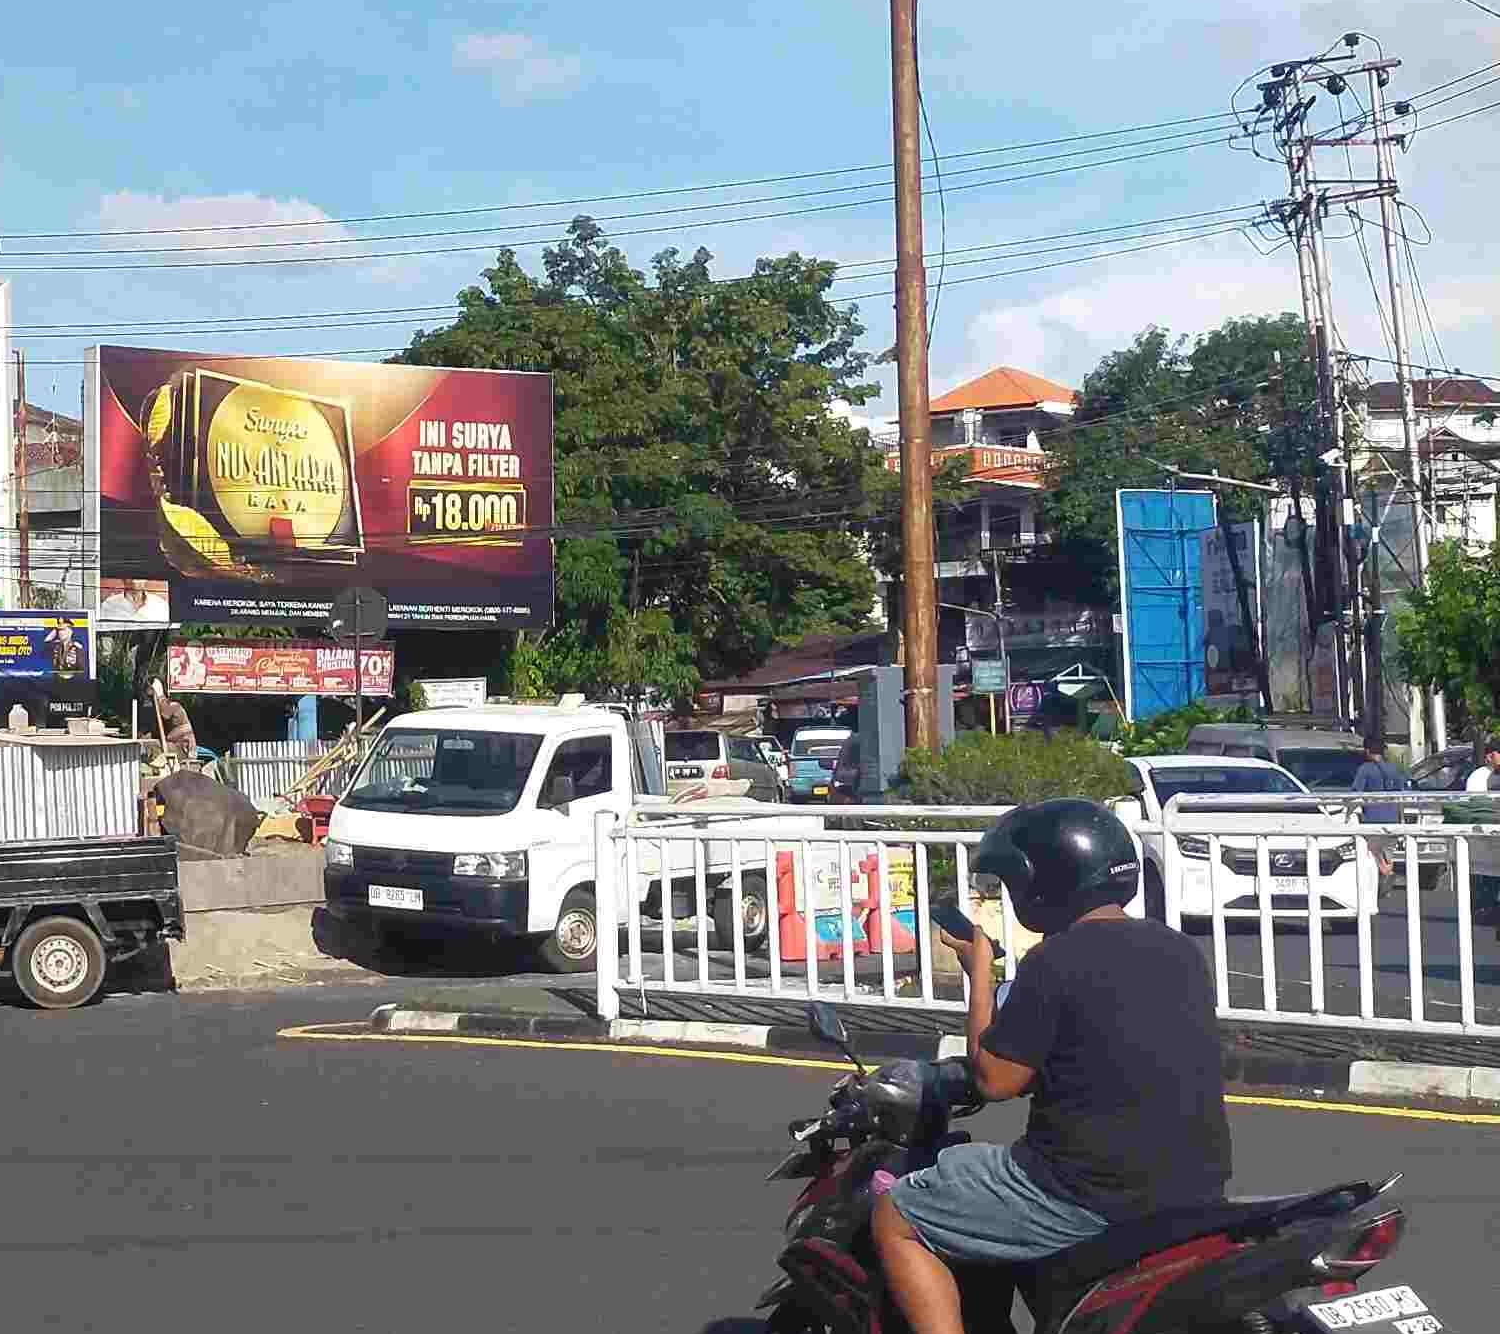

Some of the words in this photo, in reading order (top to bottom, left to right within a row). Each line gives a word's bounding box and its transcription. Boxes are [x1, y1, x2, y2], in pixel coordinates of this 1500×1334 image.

[419, 420, 445, 447] INI
[451, 421, 512, 451] SURYA
[216, 439, 339, 496] NUSANTARA
[411, 450, 463, 476] TANPA
[467, 452, 520, 479] FILTER
